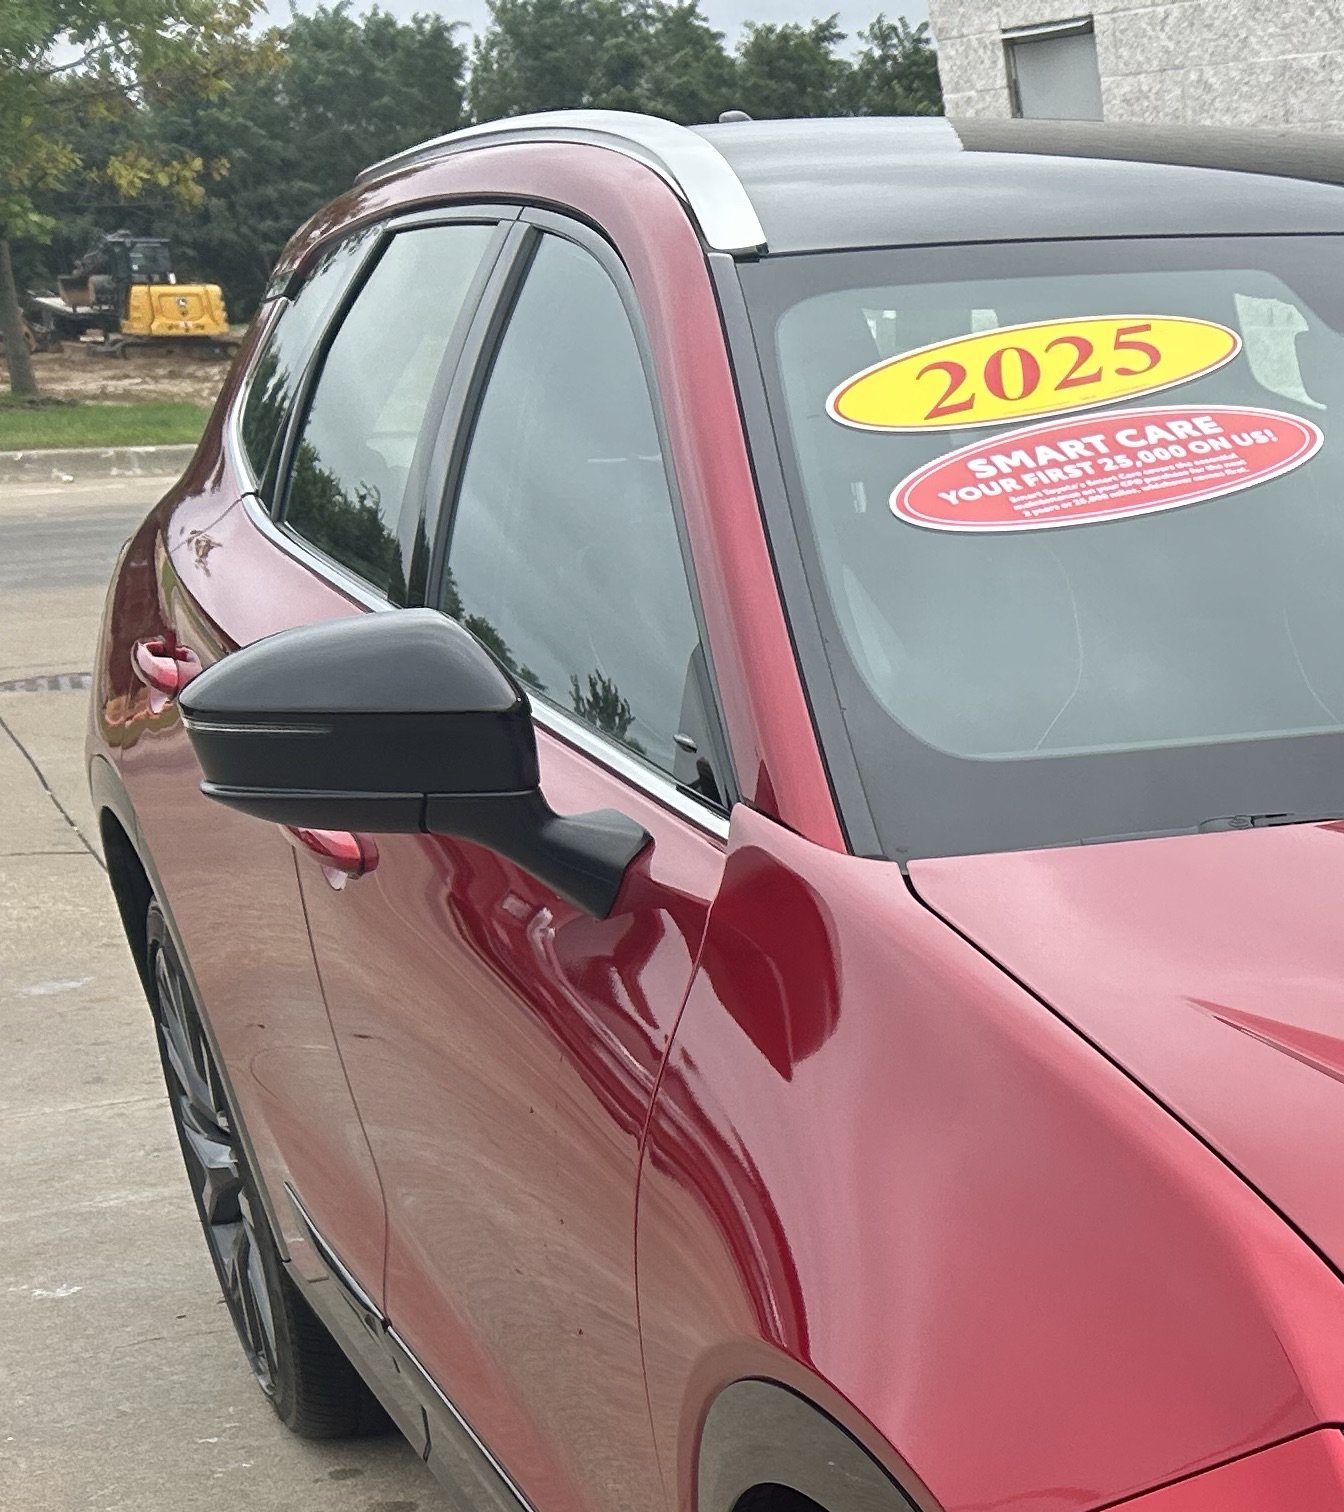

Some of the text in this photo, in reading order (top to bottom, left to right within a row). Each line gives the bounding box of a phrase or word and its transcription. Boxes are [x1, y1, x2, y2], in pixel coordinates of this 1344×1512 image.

[916, 324, 1162, 420] 2025
[938, 429, 1278, 505] YOUR FIRST 25,000 ON US!
[967, 415, 1224, 479] SMART CARE
